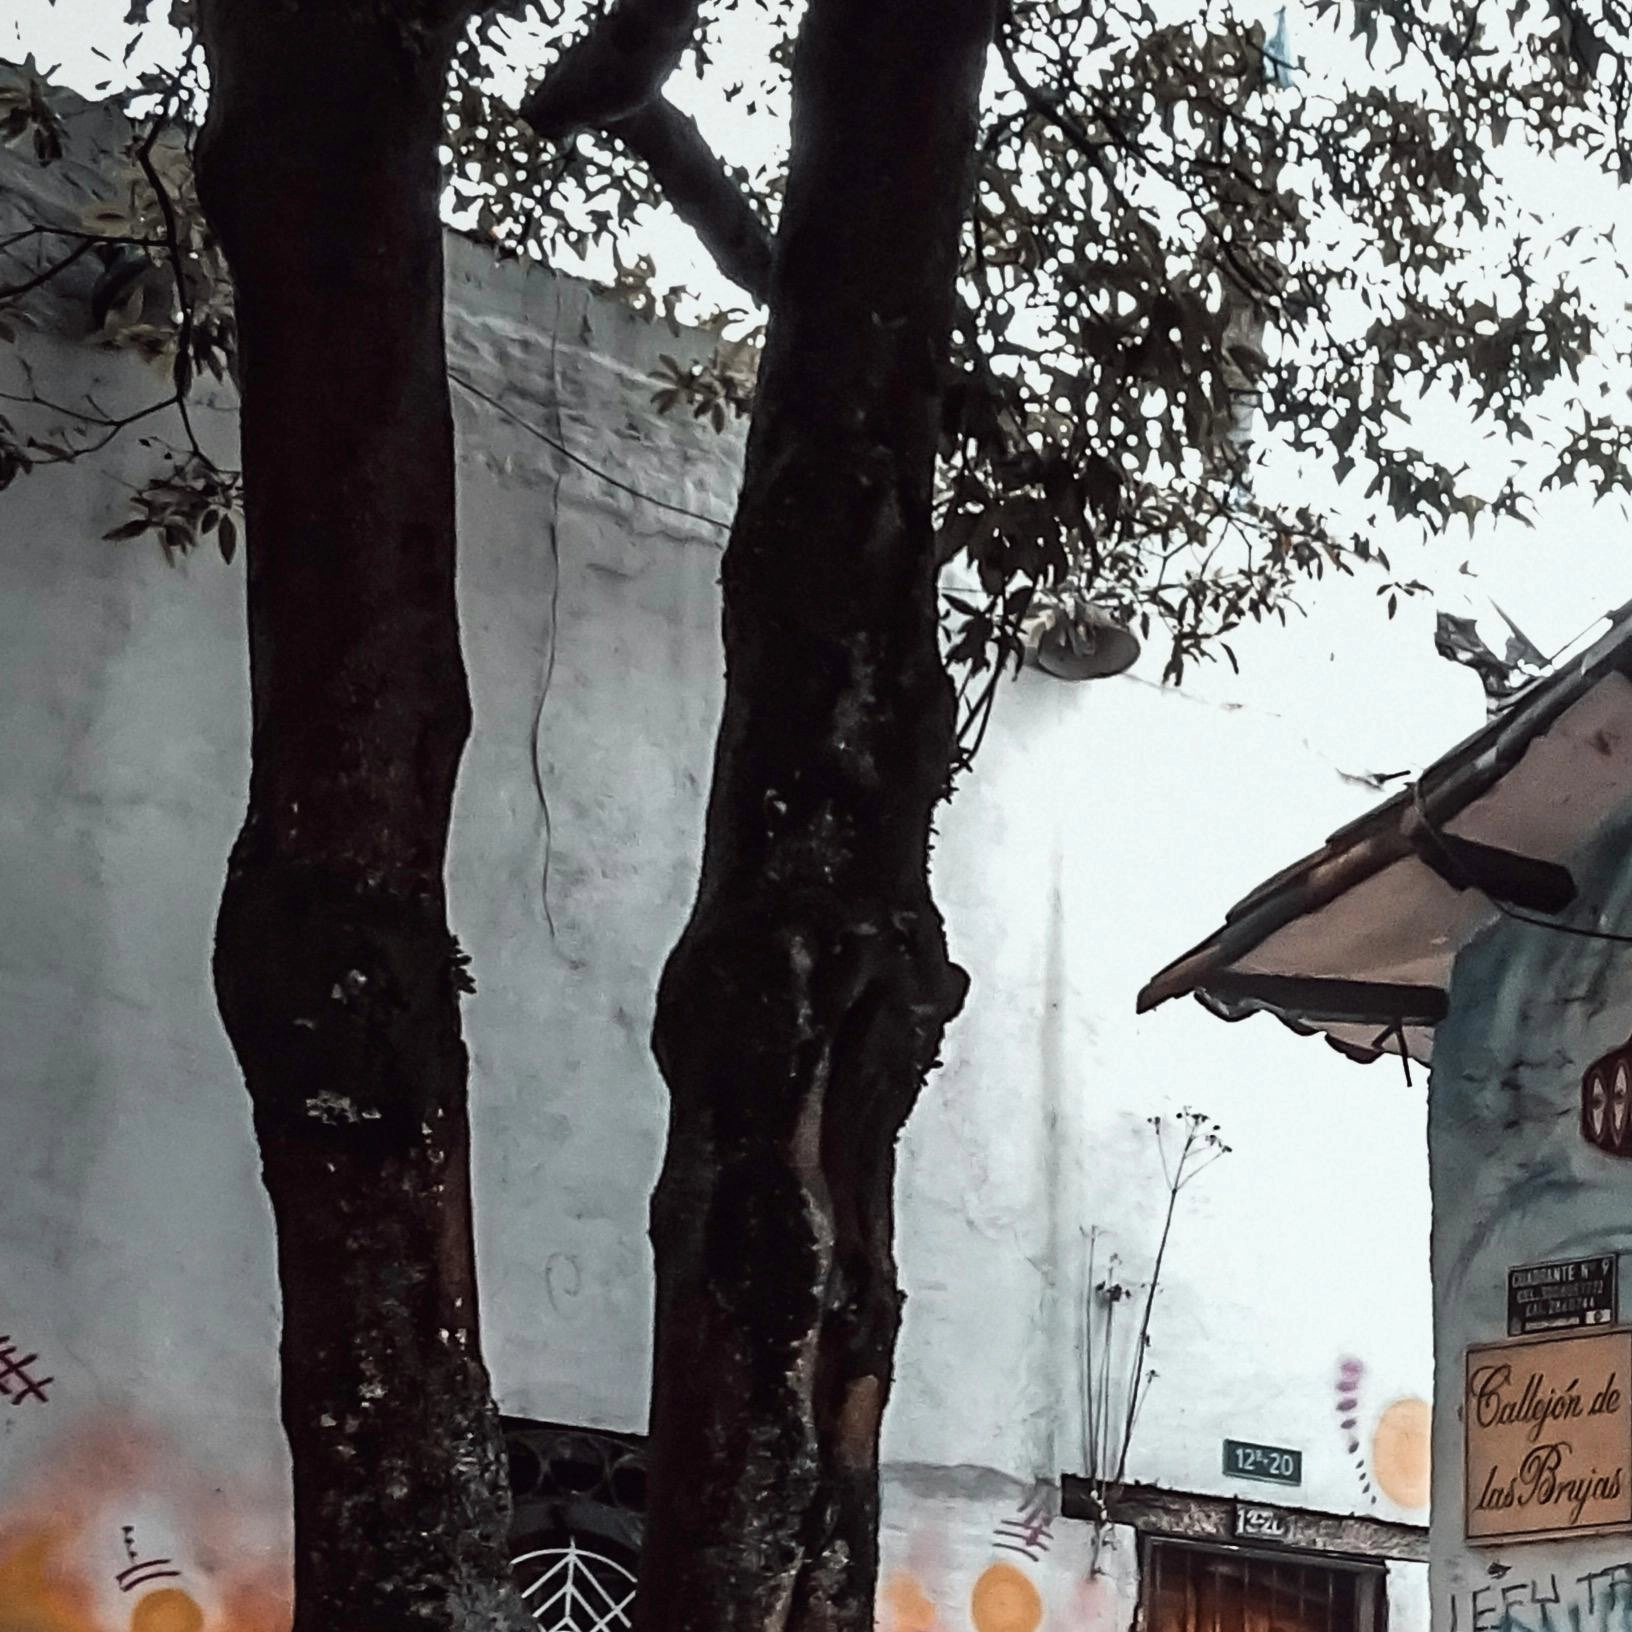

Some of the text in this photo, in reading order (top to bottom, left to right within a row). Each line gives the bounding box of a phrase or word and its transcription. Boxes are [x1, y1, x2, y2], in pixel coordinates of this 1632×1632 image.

[1601, 1258, 1611, 1276] 9
[1470, 1363, 1621, 1443] Callejón de
[1474, 1441, 1623, 1526] las Brujas
